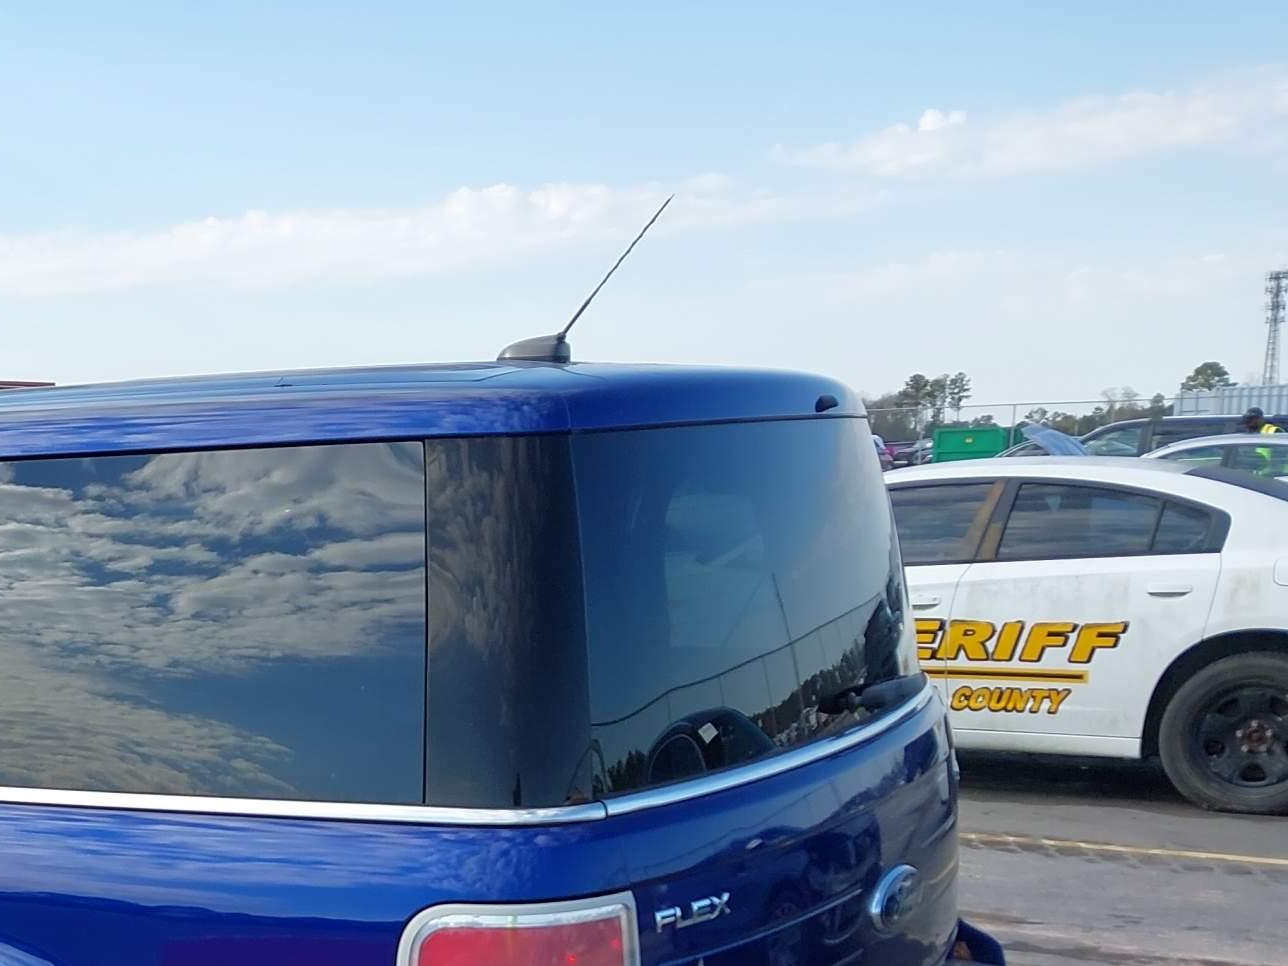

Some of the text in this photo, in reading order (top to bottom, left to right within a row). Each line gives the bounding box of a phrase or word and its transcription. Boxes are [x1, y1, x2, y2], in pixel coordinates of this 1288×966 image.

[914, 618, 1129, 663] ERIFF
[951, 686, 1072, 714] COUNTY
[654, 891, 731, 933] FLEX
